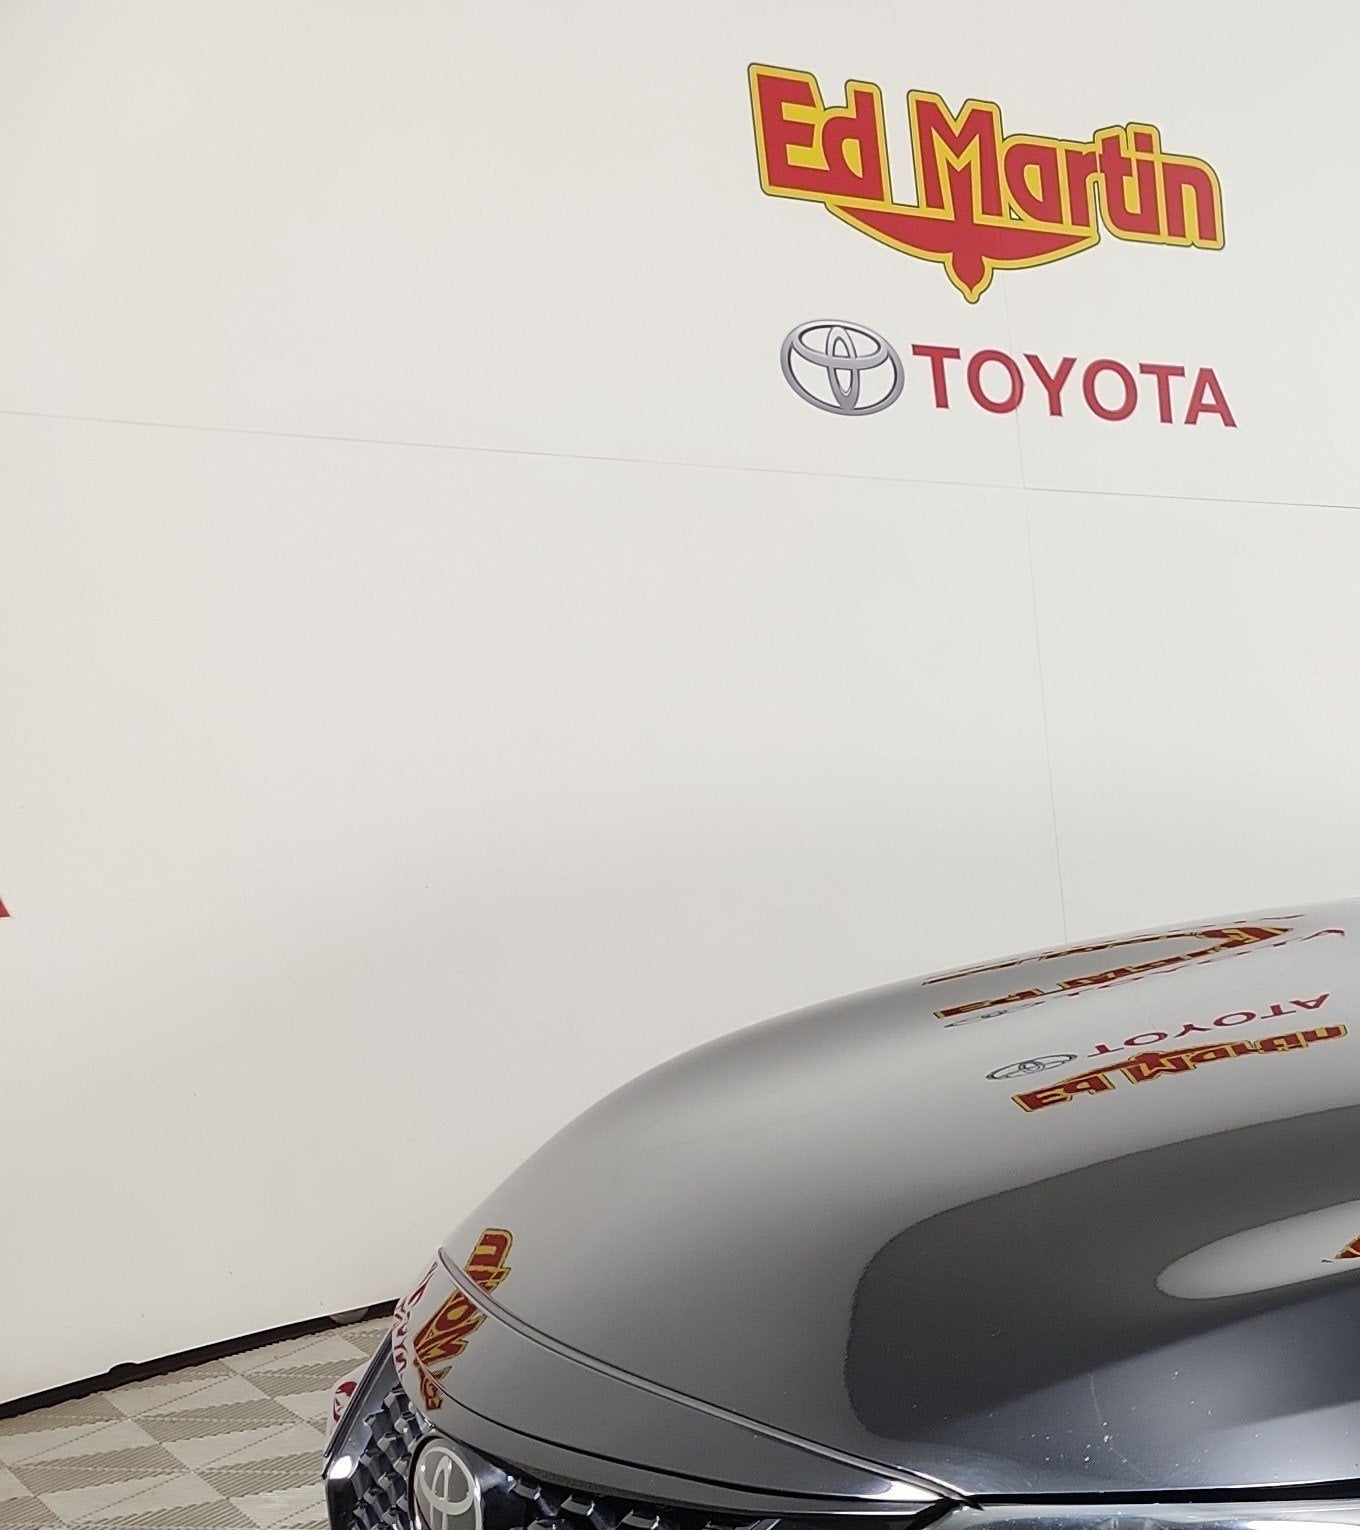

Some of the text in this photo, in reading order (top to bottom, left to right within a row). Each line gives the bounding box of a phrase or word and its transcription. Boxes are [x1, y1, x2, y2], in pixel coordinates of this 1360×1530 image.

[748, 63, 1225, 250] Ed Martin
[911, 343, 1238, 428] TOYOTA
